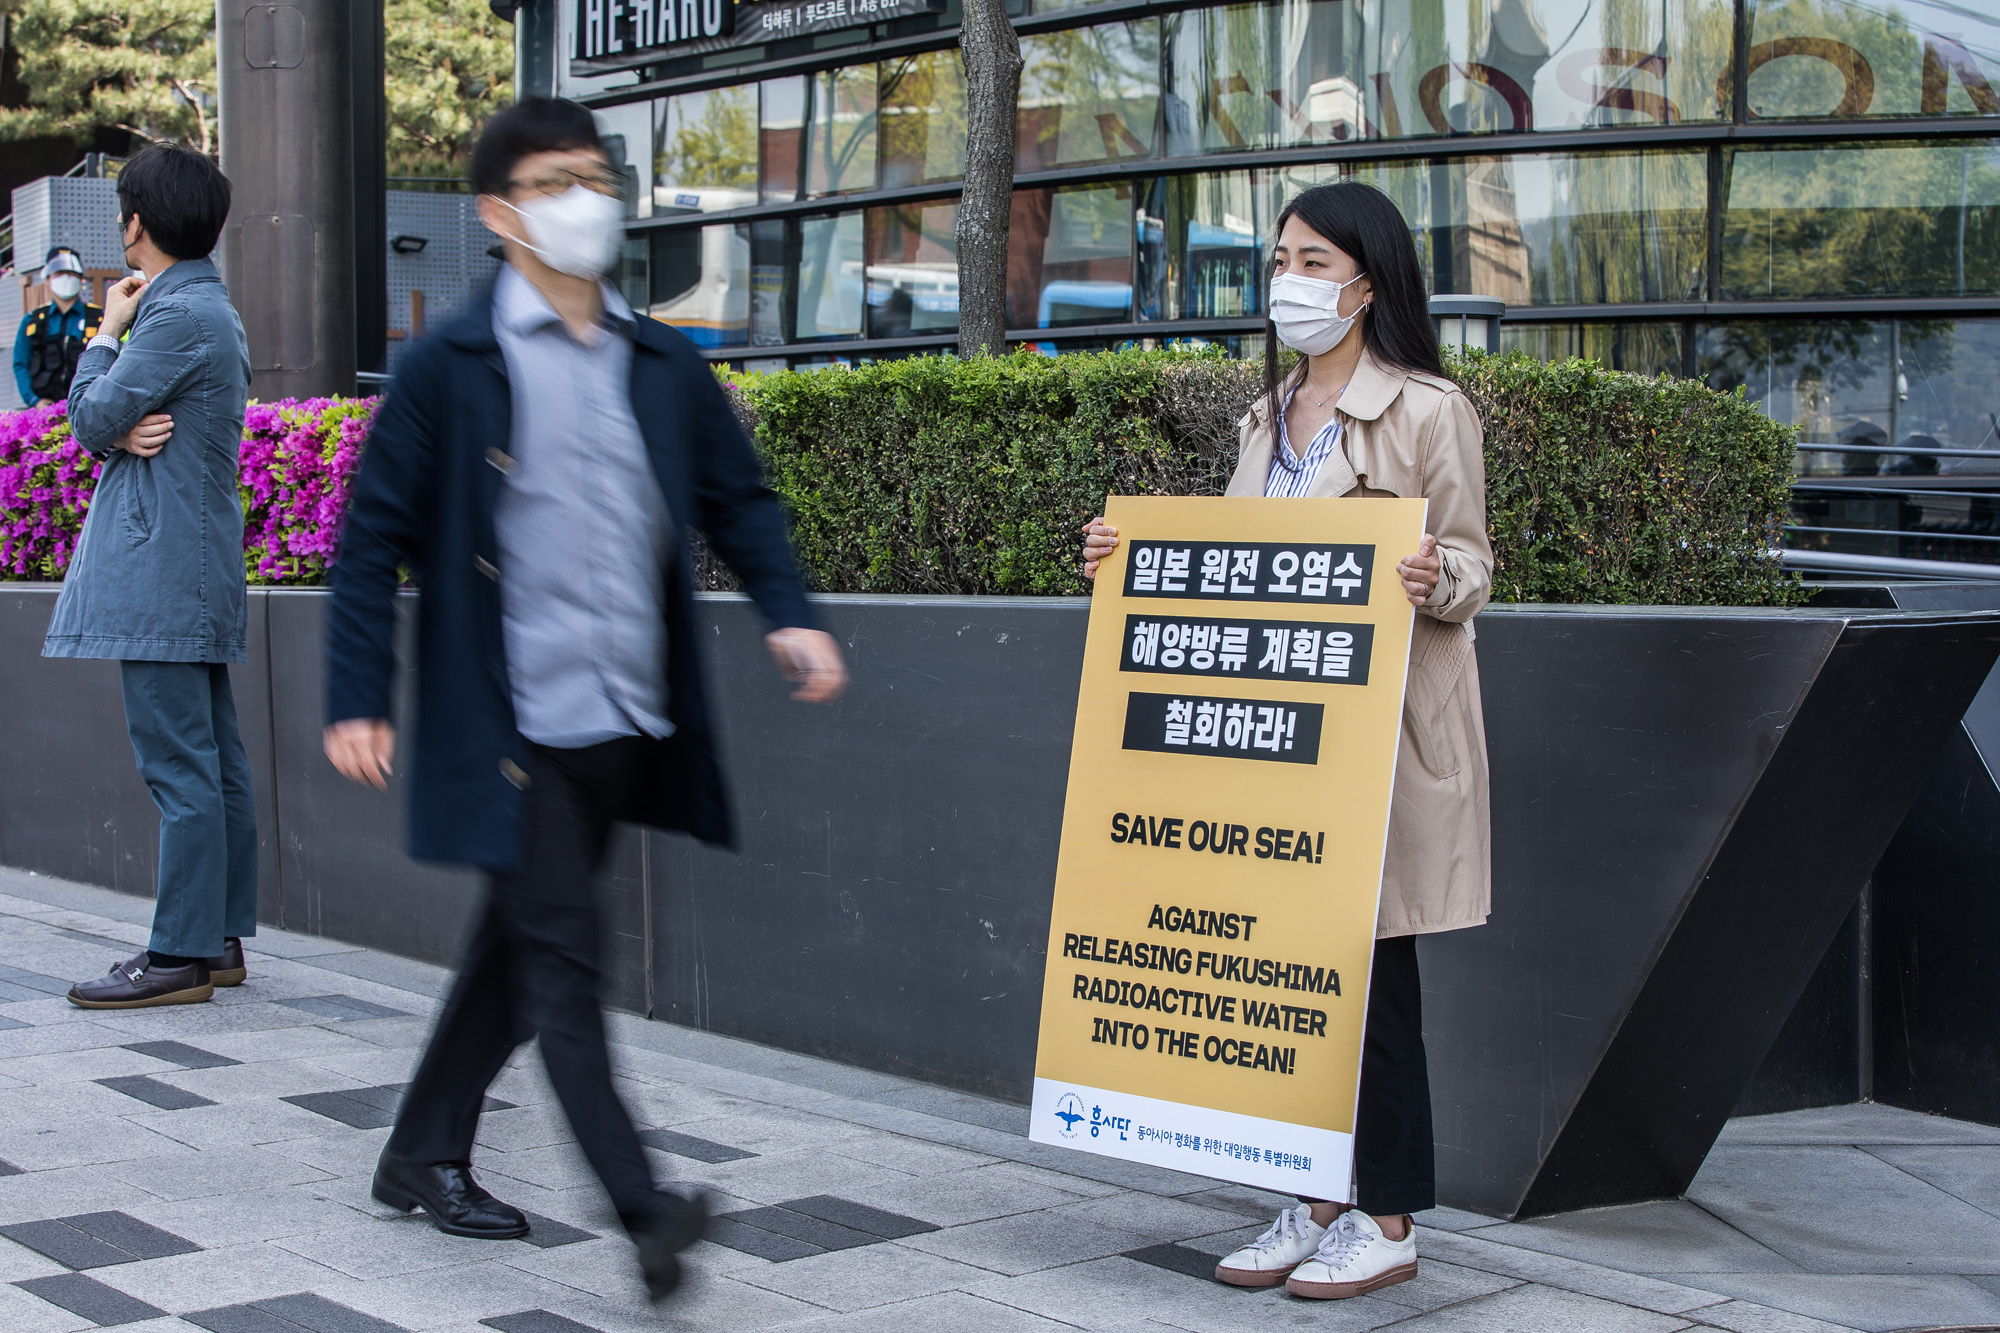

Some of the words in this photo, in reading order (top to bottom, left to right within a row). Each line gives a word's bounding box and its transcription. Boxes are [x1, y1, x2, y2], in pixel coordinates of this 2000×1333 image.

[762, 9, 792, 31] 더하루
[806, 0, 846, 23] 푸드코트
[1132, 547, 1191, 593] 일본
[1200, 549, 1260, 594] 원전
[1268, 551, 1363, 597] 오염수
[1132, 621, 1249, 671] 해양방류
[1258, 627, 1354, 678] 계획을
[1164, 699, 1297, 752] 철회하라!
[1110, 812, 1184, 848] SAVE
[1188, 820, 1249, 855] OUR
[1254, 826, 1325, 864] SEA!
[1147, 904, 1257, 942] AGAINST
[1063, 933, 1193, 974] RELEASING
[1195, 952, 1342, 996] FUKUSHIMA
[1072, 974, 1236, 1023] RADIOACTIVE
[1242, 999, 1327, 1037] WATER
[1091, 1017, 1149, 1050] INTO
[1154, 1028, 1199, 1059] THE
[1203, 1035, 1296, 1075] OCEAN!
[1090, 1105, 1131, 1141] 흥사단
[1137, 1125, 1173, 1145] 동아시아
[1174, 1132, 1201, 1151] 평화를
[1203, 1138, 1222, 1155] 위한
[1224, 1142, 1261, 1163] 대일행동
[1263, 1149, 1312, 1172] 특별위원회
